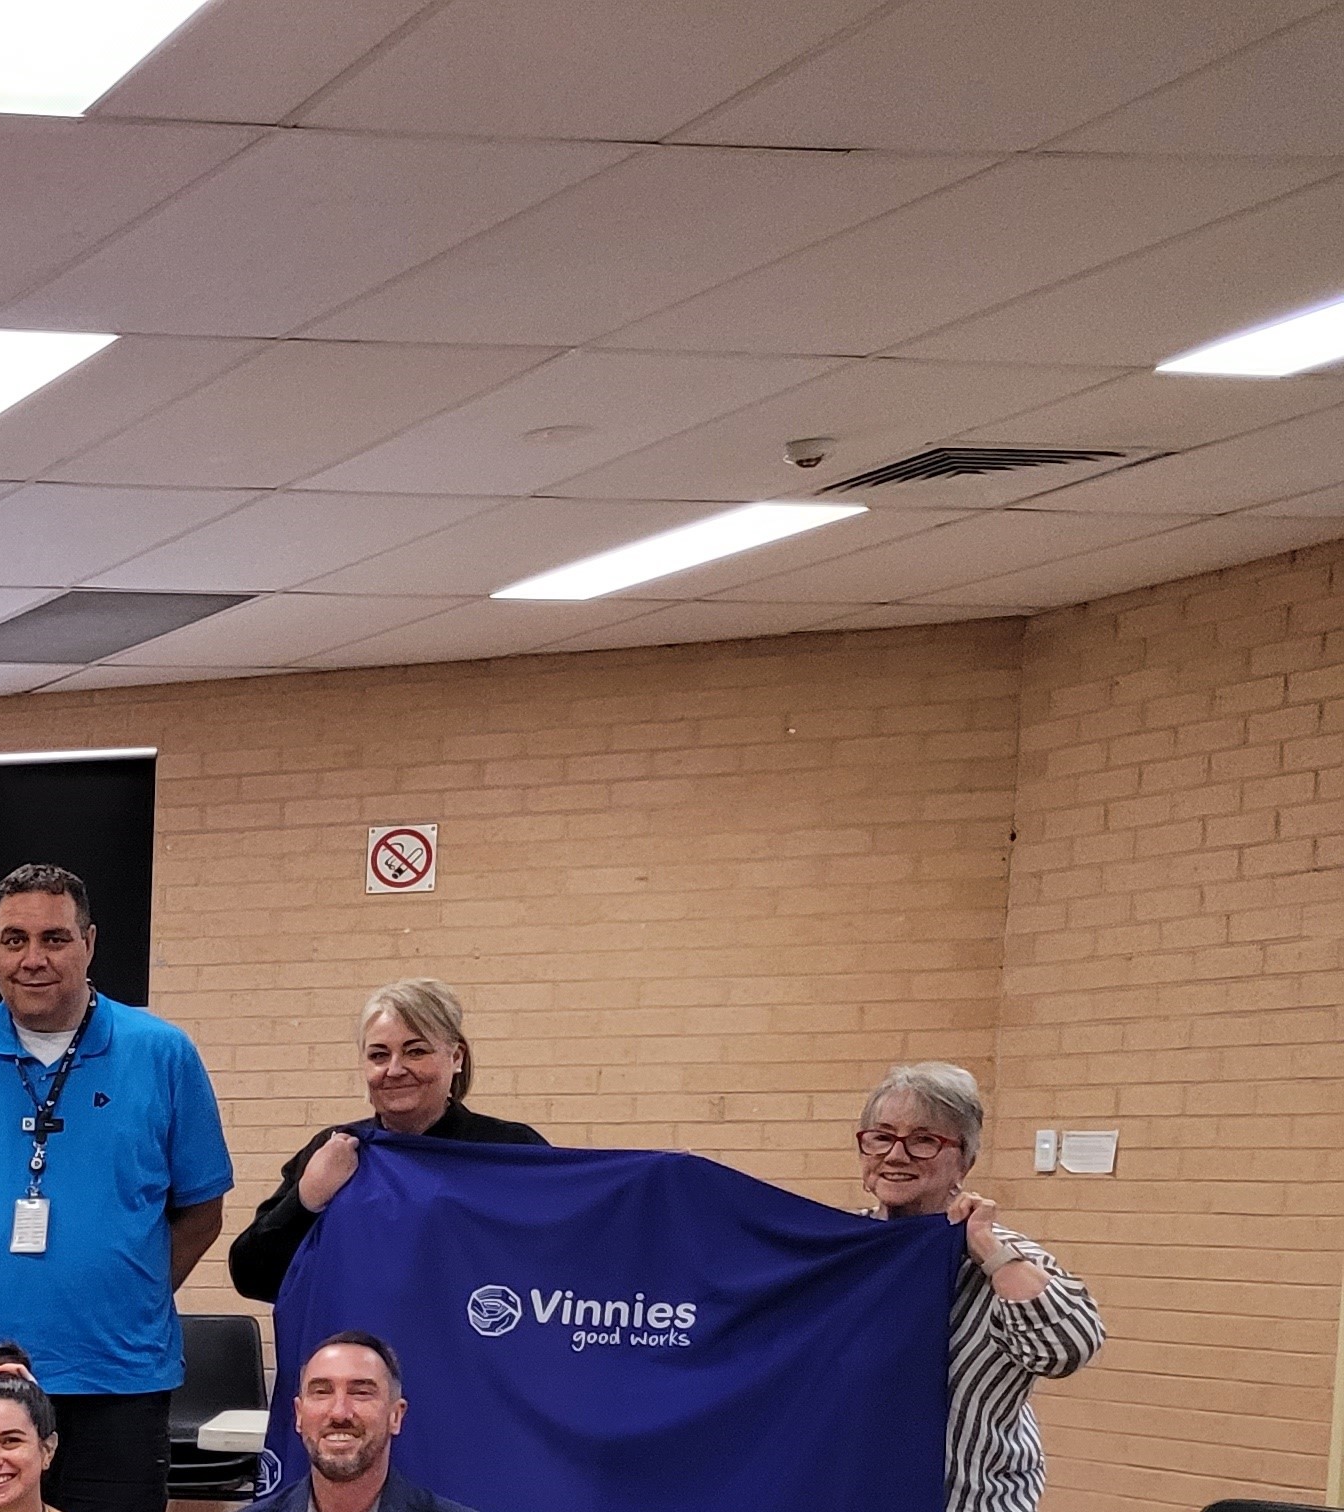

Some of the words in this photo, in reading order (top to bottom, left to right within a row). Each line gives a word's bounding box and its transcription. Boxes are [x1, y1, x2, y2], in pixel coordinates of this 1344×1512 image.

[530, 1289, 697, 1329] Vinnies
[571, 1327, 621, 1352] good
[630, 1329, 691, 1347] works
